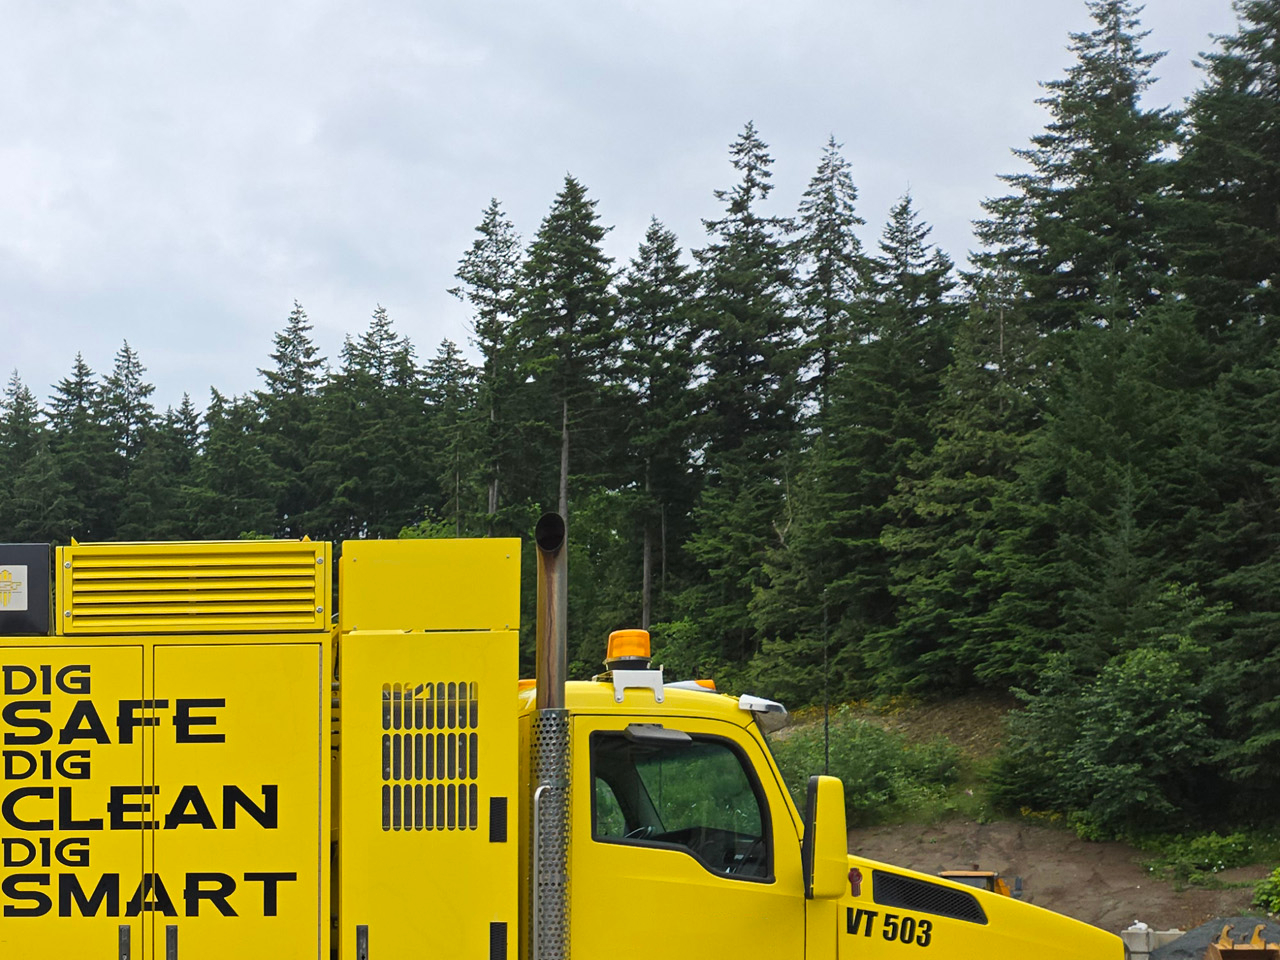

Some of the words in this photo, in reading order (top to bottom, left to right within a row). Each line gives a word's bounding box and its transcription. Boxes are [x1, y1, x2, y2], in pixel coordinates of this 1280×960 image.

[2, 665, 91, 695] DIG
[2, 698, 226, 745] SAFE
[2, 750, 91, 780] DIG
[2, 784, 278, 831] CLEAN
[2, 837, 90, 867] DIG
[2, 872, 297, 917] SMART
[846, 907, 879, 938] VT
[882, 913, 933, 947] 503
